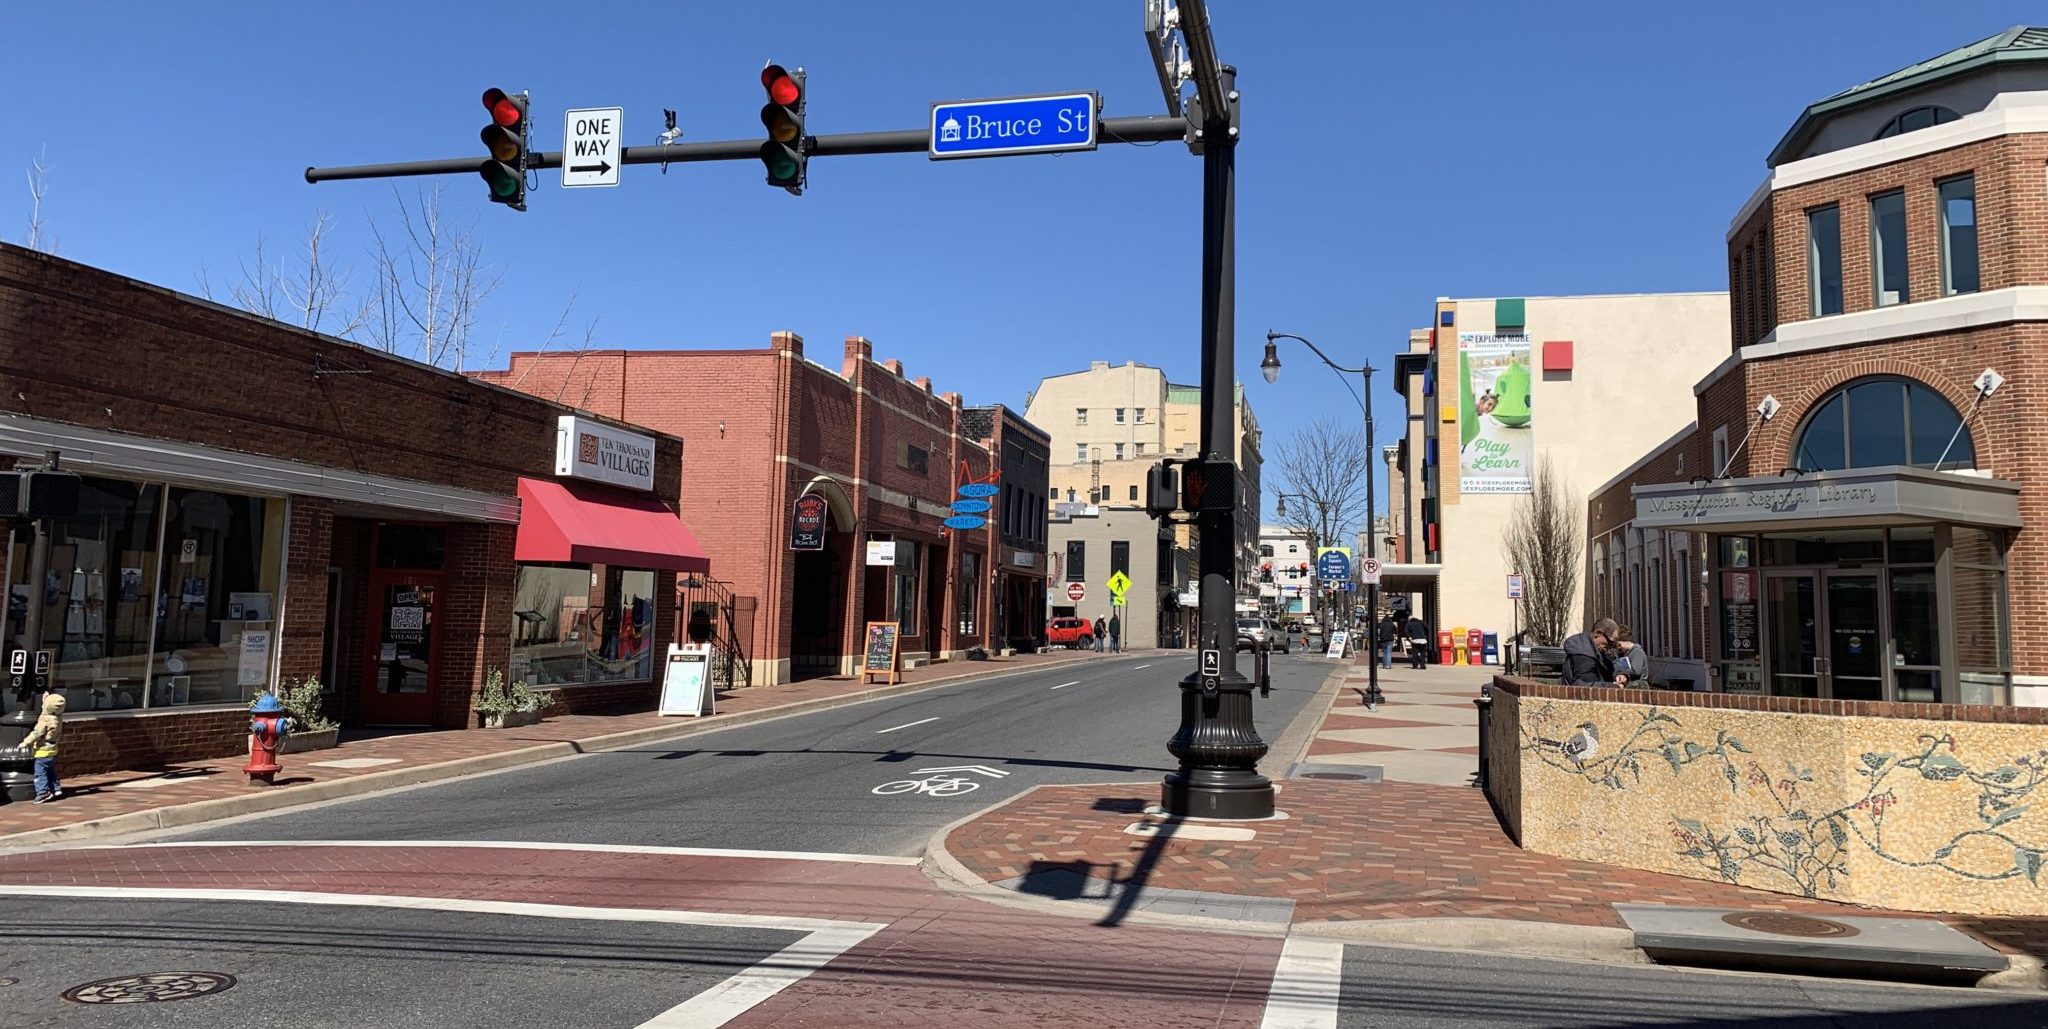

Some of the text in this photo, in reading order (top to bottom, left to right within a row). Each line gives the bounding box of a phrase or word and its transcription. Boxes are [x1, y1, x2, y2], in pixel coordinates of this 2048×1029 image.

[576, 118, 611, 136] ONE
[966, 108, 1088, 140] Bruce St
[574, 138, 611, 157] WAY
[1474, 334, 1530, 343] EXPLORE MORE
[601, 437, 650, 459] TEN THOUSAND
[1474, 438, 1511, 457] Play
[600, 451, 650, 477] VILLAGES
[1471, 455, 1521, 472] Learn
[964, 485, 993, 495] AGORA
[1650, 482, 1878, 513] Massanutten Regional Library
[953, 502, 988, 510] DOWNTOWN
[398, 592, 419, 602] OPEN
[247, 635, 266, 644] SHOP
